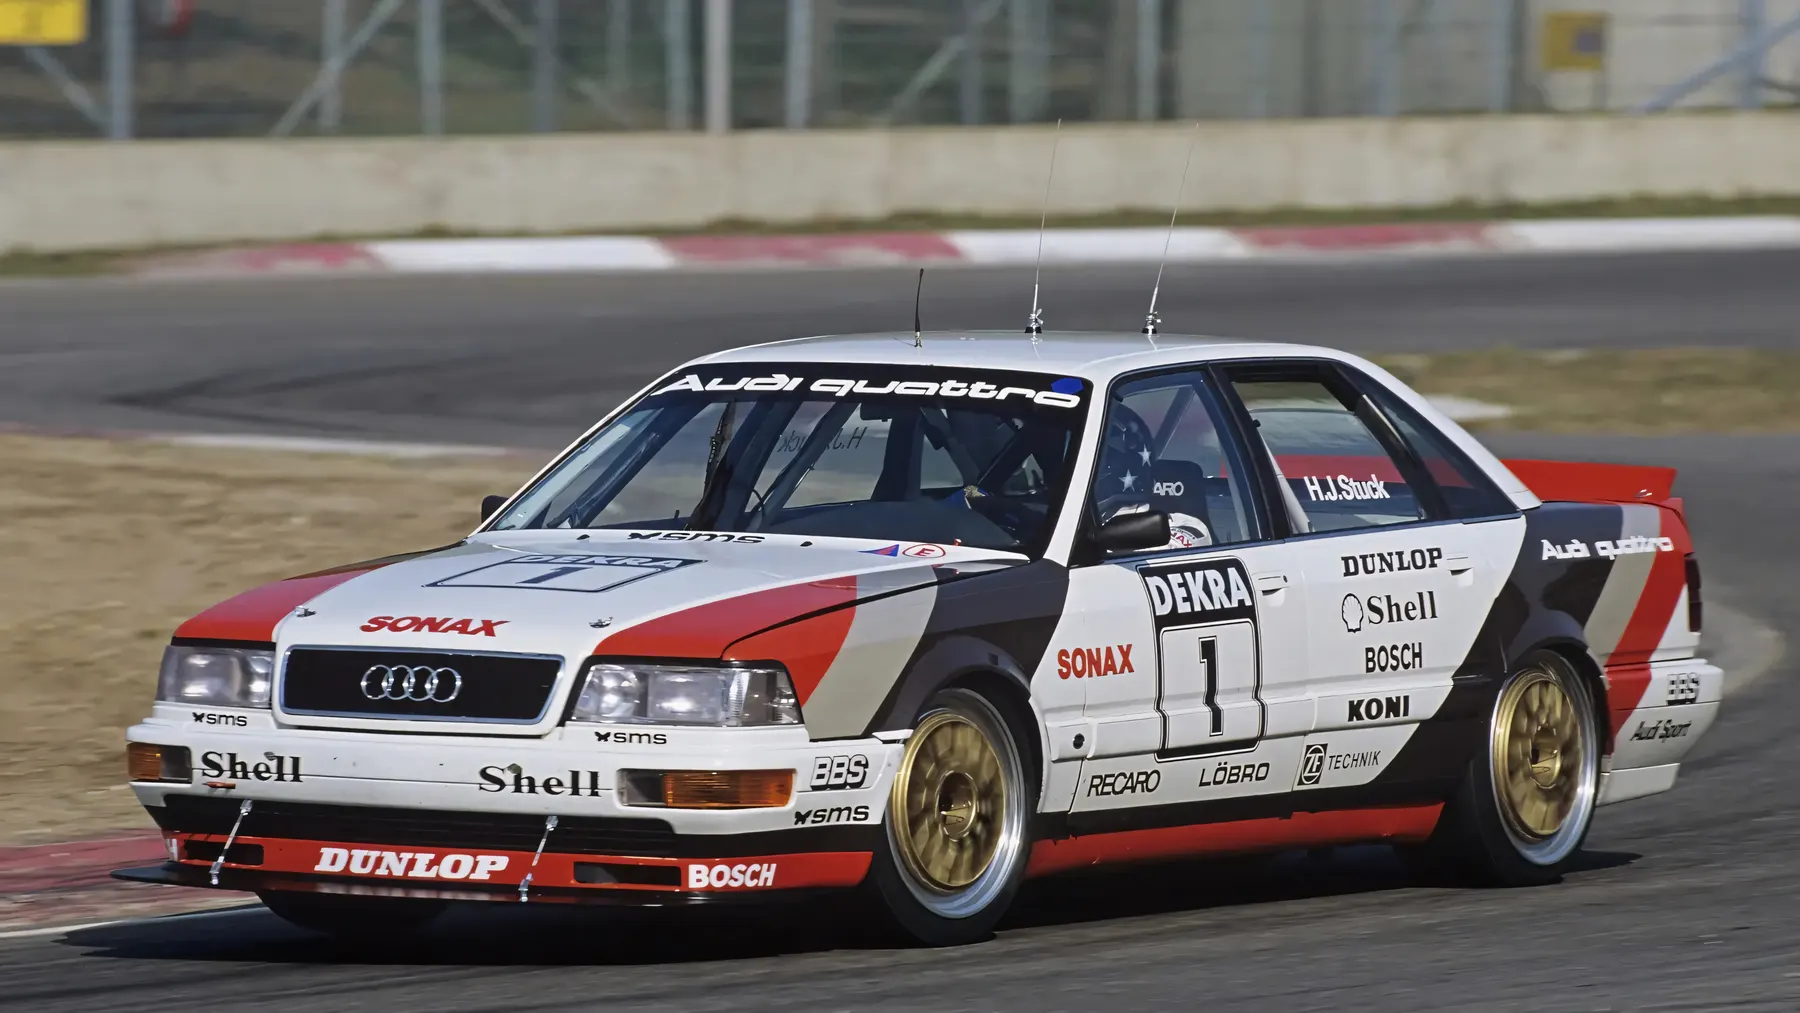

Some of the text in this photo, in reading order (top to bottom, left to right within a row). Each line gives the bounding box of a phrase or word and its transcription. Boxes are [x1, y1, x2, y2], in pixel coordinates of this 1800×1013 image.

[650, 373, 1080, 408] Audi quattro
[1153, 480, 1184, 496] ARO
[1303, 473, 1390, 501] H.J.Stuck
[658, 532, 766, 544] sms
[1541, 535, 1675, 560] Audi quattro
[517, 555, 684, 568] DEKRA
[1341, 547, 1443, 577] DUNLOP
[515, 567, 593, 584] 1
[1145, 567, 1252, 616] DEKRA
[1367, 590, 1438, 625] Shell
[360, 615, 511, 637] SONAX
[1057, 643, 1135, 680] SONAX
[1365, 642, 1423, 673] BOSCH
[1199, 635, 1223, 737] 1
[1666, 672, 1699, 706] BBS
[206, 712, 248, 727] sms
[1347, 695, 1410, 722] KONI
[613, 731, 667, 745] sms
[1629, 718, 1692, 743] Audi Sport
[201, 750, 304, 784] Shell
[810, 754, 869, 791] BBS
[1328, 750, 1381, 770] TECHNIK
[479, 765, 602, 797] Shell
[1087, 768, 1161, 797] RECARO
[1198, 761, 1270, 787] LÖBRO
[811, 805, 869, 824] sms
[314, 847, 509, 880] DUNLOP
[688, 863, 776, 889] BOSCH
